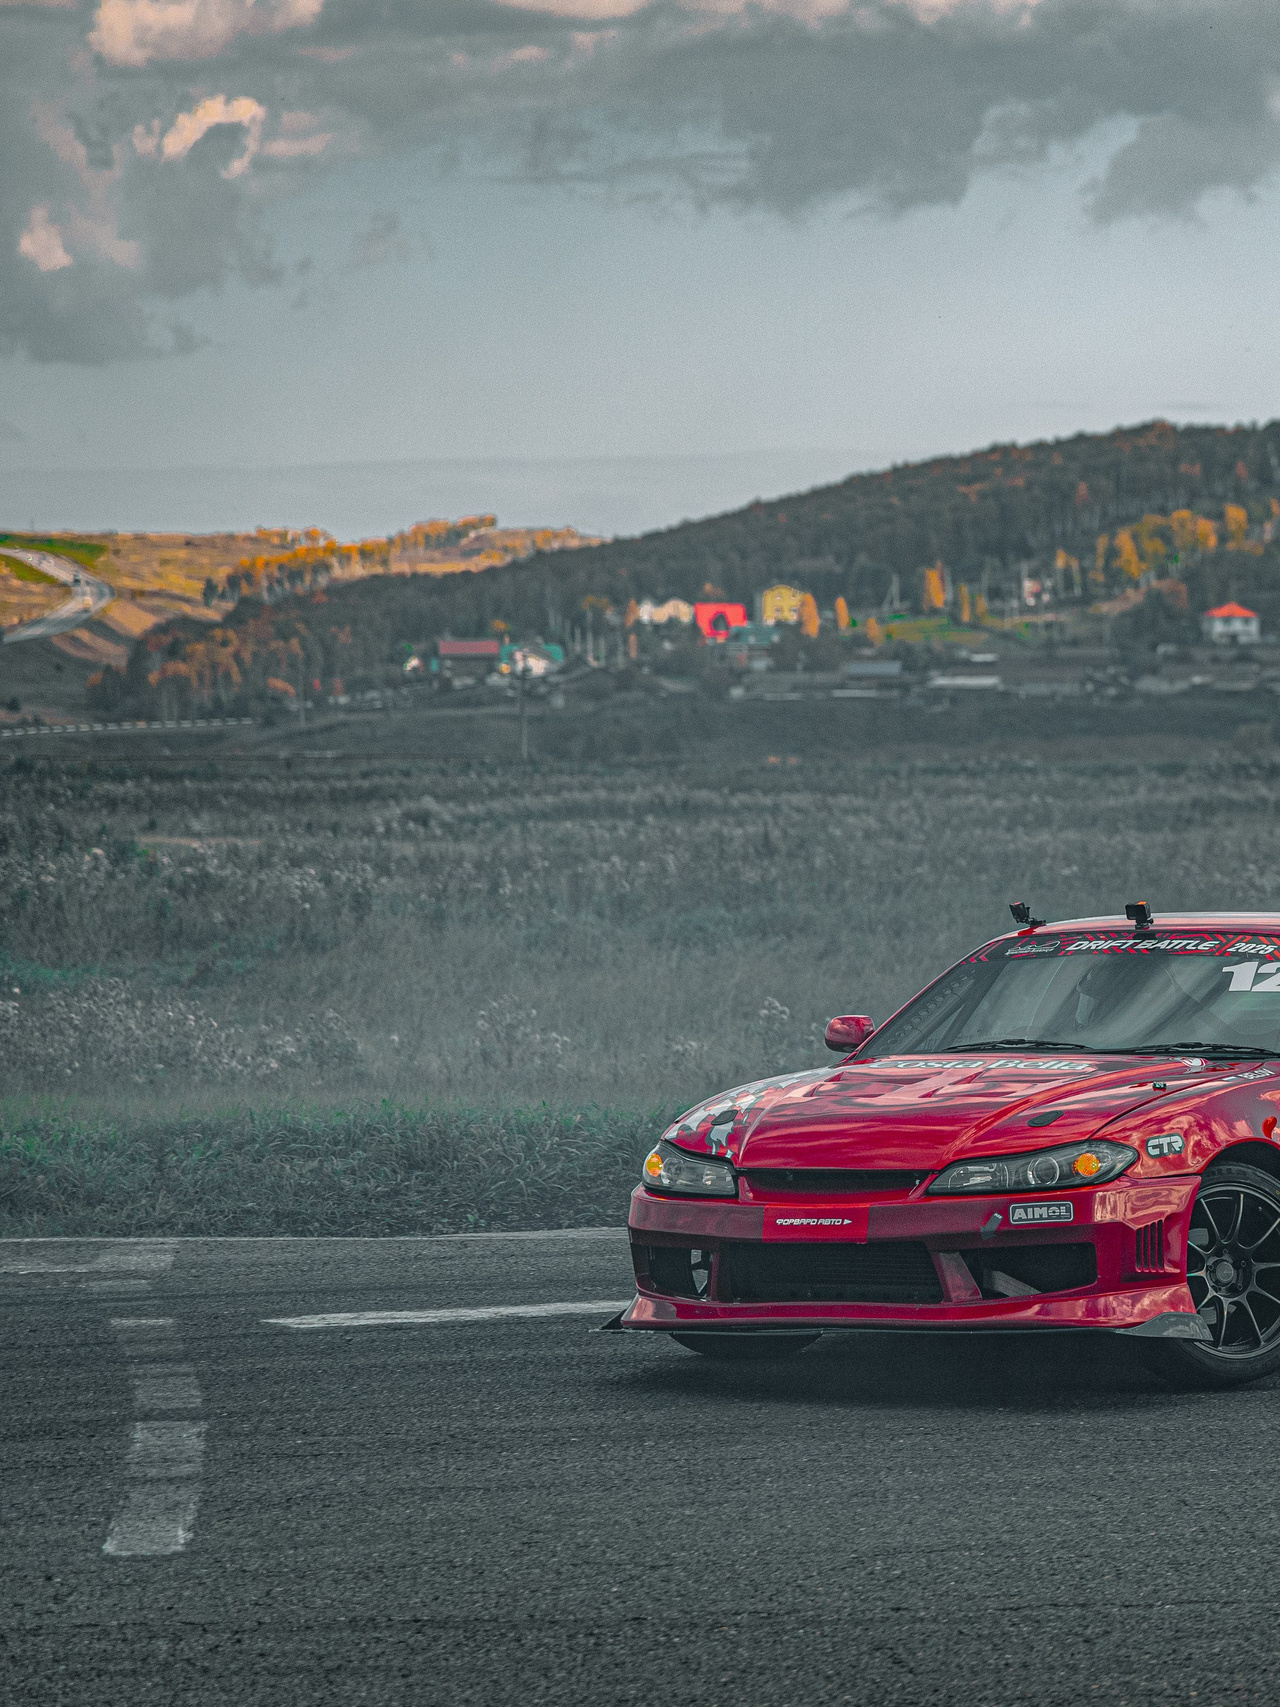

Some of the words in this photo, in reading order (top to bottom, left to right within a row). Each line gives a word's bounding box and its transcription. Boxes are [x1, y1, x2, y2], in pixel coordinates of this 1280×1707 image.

[1065, 939, 1134, 951] DRIFT
[1133, 939, 1221, 951] BATTLE
[1226, 942, 1278, 955] 2025
[985, 1059, 1089, 1070] Bella
[1147, 1135, 1183, 1156] CTR
[1012, 1206, 1070, 1220] AIMOL
